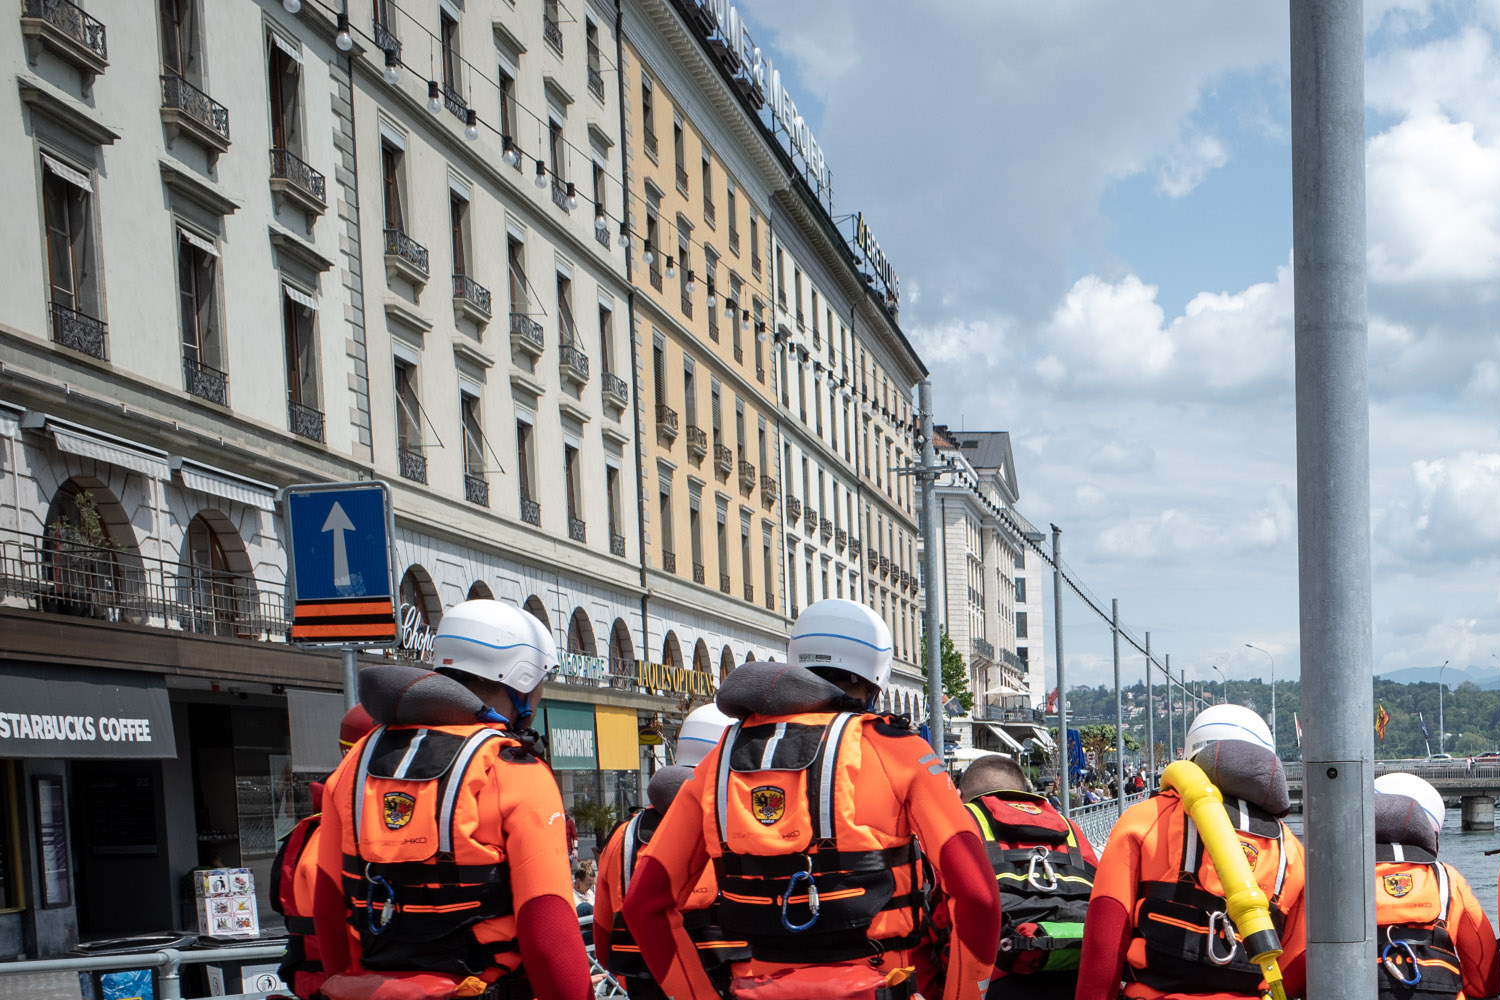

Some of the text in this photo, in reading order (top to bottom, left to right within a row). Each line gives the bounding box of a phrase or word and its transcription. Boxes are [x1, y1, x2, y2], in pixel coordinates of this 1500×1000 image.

[706, 0, 750, 72] UME
[765, 56, 826, 188] MERCIER
[864, 224, 900, 307] BREITLING
[637, 659, 715, 697] JAQUES OPTICIENS
[0, 712, 152, 742] STARBUCKS COFFEE
[551, 728, 593, 758] HOMEOPATHIE
